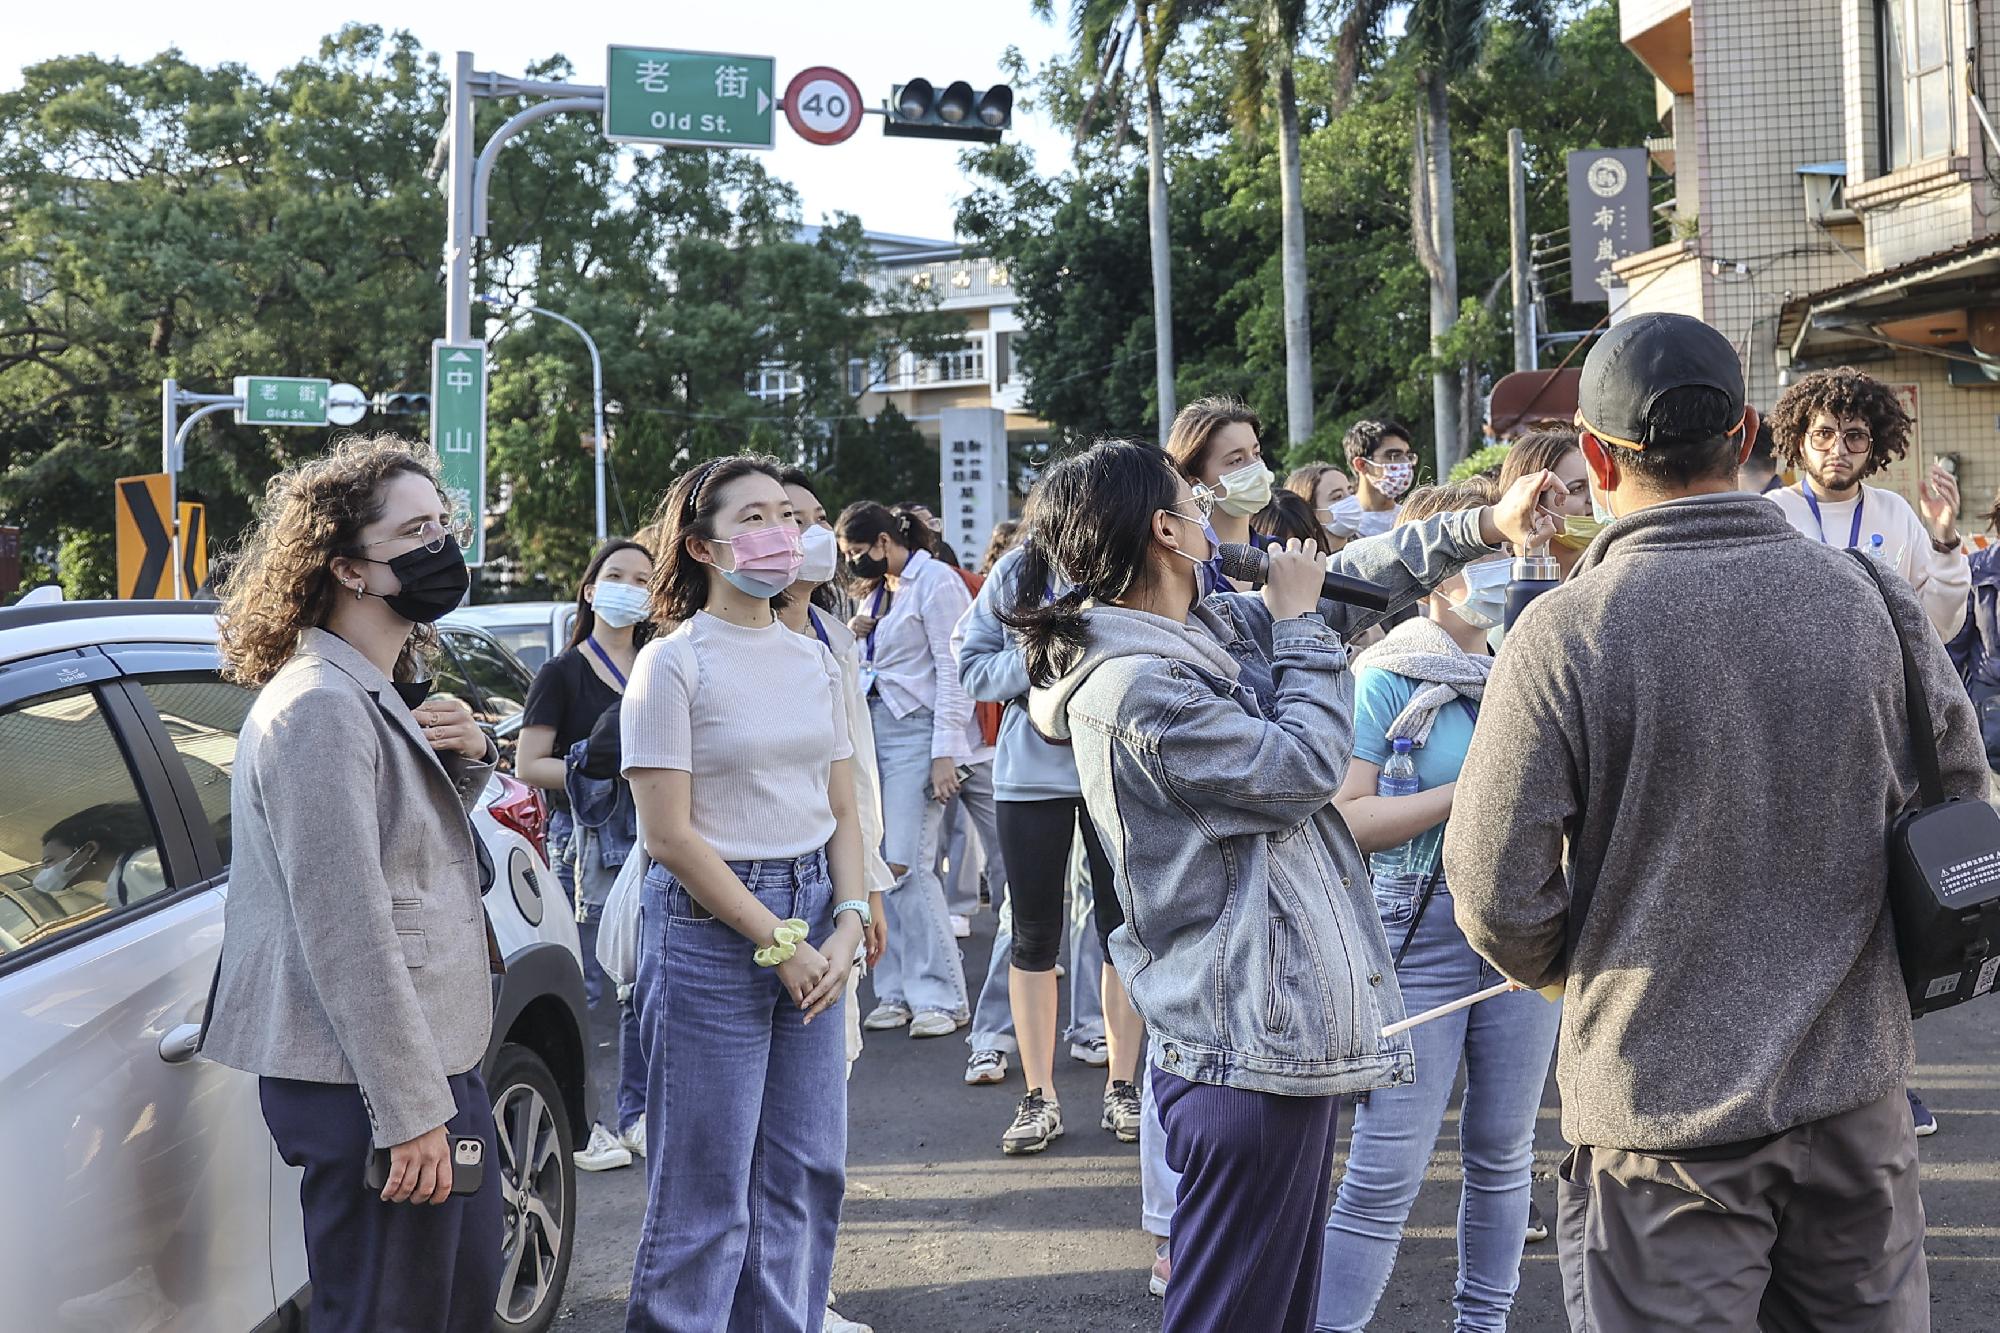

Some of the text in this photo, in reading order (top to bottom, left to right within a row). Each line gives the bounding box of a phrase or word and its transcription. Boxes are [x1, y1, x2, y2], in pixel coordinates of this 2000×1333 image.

[636, 60, 749, 98] 老街
[802, 93, 845, 117] 40
[650, 111, 732, 133] Old St.
